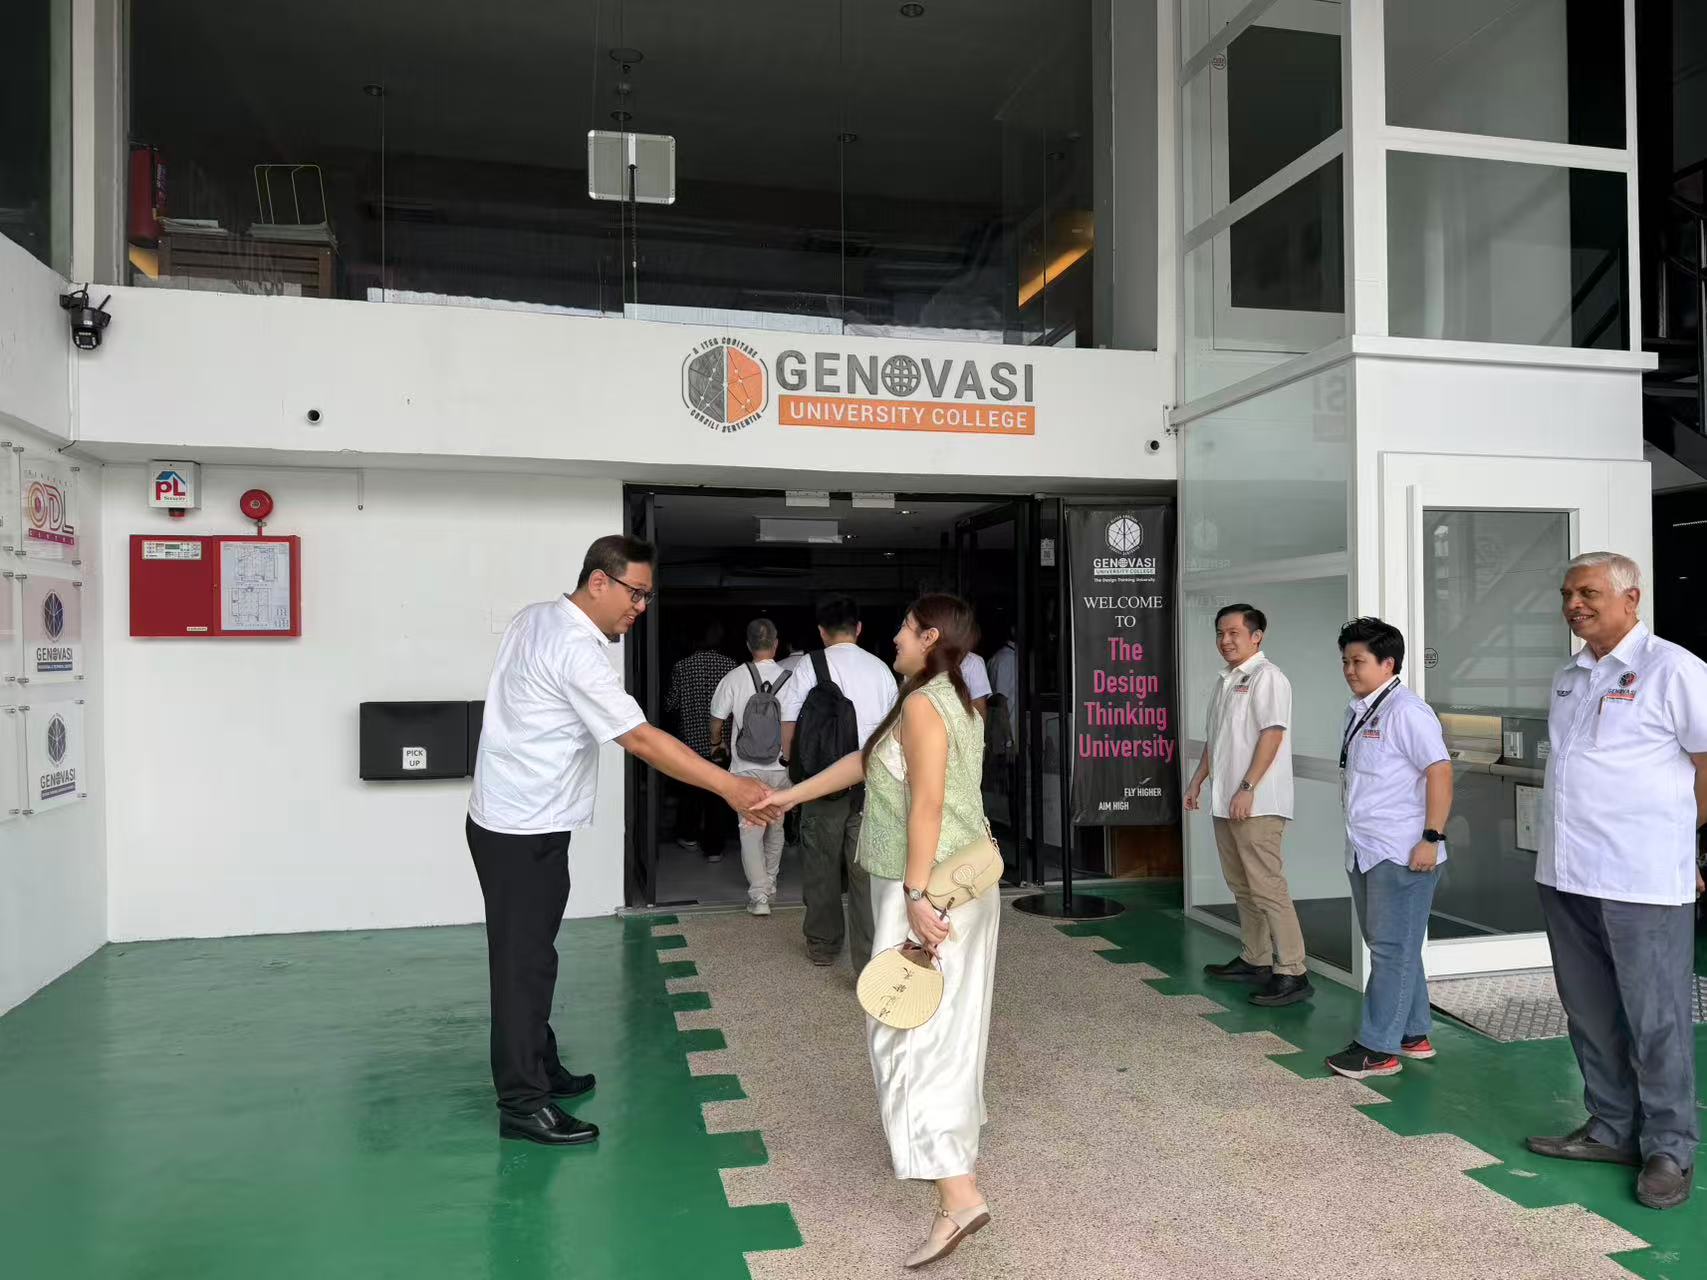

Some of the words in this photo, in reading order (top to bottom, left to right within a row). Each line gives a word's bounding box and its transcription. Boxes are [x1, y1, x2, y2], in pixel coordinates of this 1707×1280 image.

[775, 350, 1034, 402] GENOVASI
[789, 401, 926, 425] UNIVERSITY
[931, 407, 1028, 429] COLLEGE
[1093, 557, 1156, 568] GENOVASI
[1083, 596, 1163, 609] WELCOME
[1114, 615, 1137, 628] TO
[36, 647, 73, 661] GENOVASI
[1107, 637, 1144, 662] The
[1093, 669, 1159, 699] Design
[1083, 701, 1168, 731] Thinking
[1078, 733, 1176, 764] University
[40, 768, 76, 789] GENOVASI
[1124, 788, 1136, 797] FLY
[1137, 787, 1162, 797] HIGHER
[1098, 801, 1112, 810] AIM
[1112, 801, 1129, 811] HIGH
